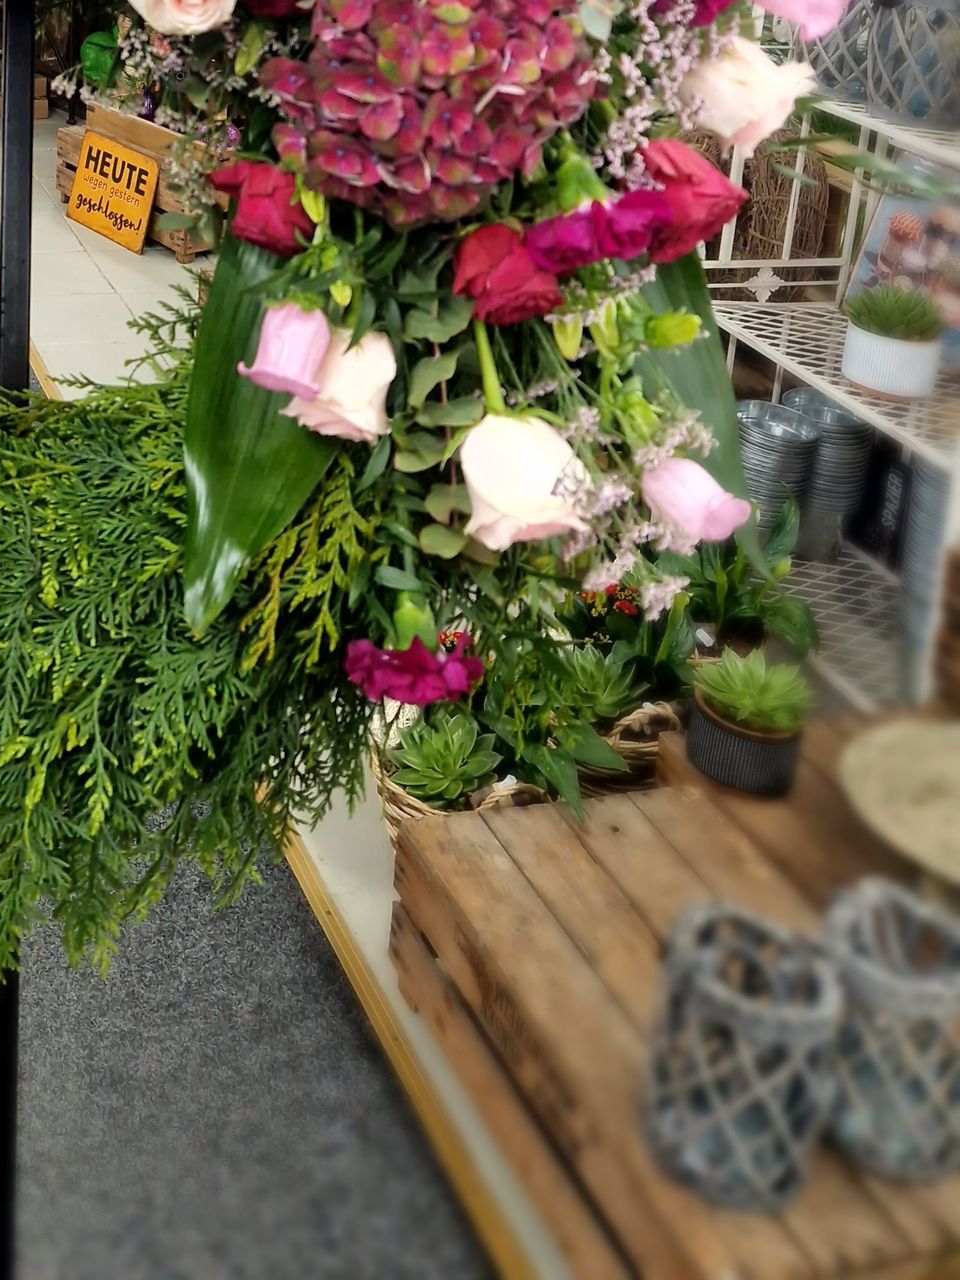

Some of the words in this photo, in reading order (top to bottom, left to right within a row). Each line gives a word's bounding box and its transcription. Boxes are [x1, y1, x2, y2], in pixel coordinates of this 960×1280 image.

[83, 173, 108, 191] wegen
[109, 185, 140, 208] gestern
[84, 146, 149, 197] HEUTE
[75, 193, 143, 235] geschlossen!
